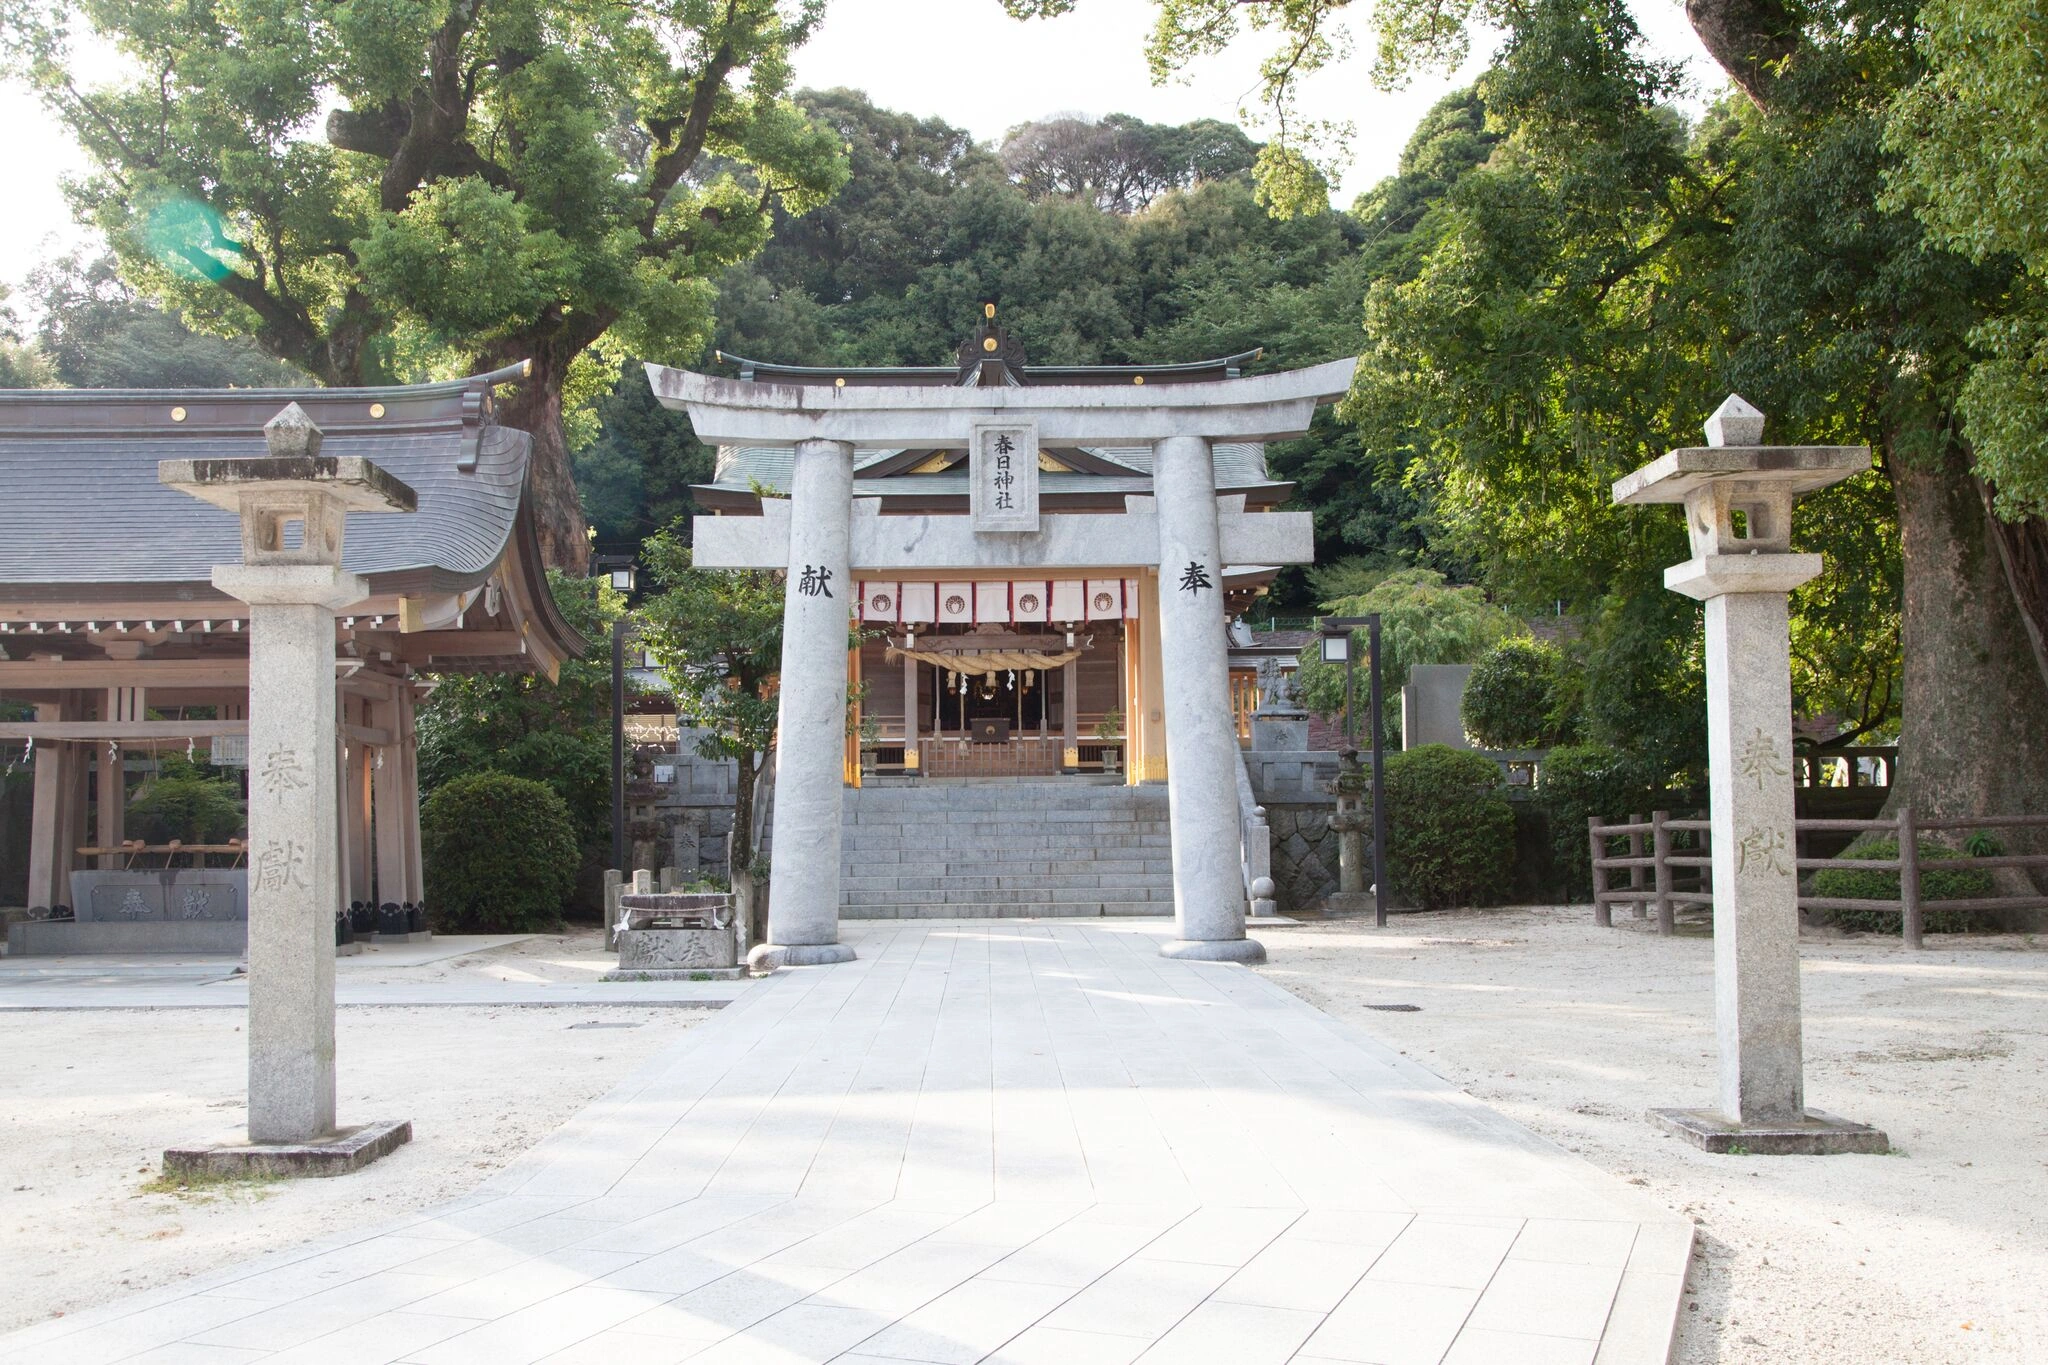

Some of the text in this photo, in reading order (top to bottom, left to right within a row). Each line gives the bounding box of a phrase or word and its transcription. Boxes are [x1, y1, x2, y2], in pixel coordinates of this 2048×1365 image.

[994, 434, 1015, 510] 春日神社
[799, 564, 833, 598] 献
[1179, 561, 1213, 597] 奉
